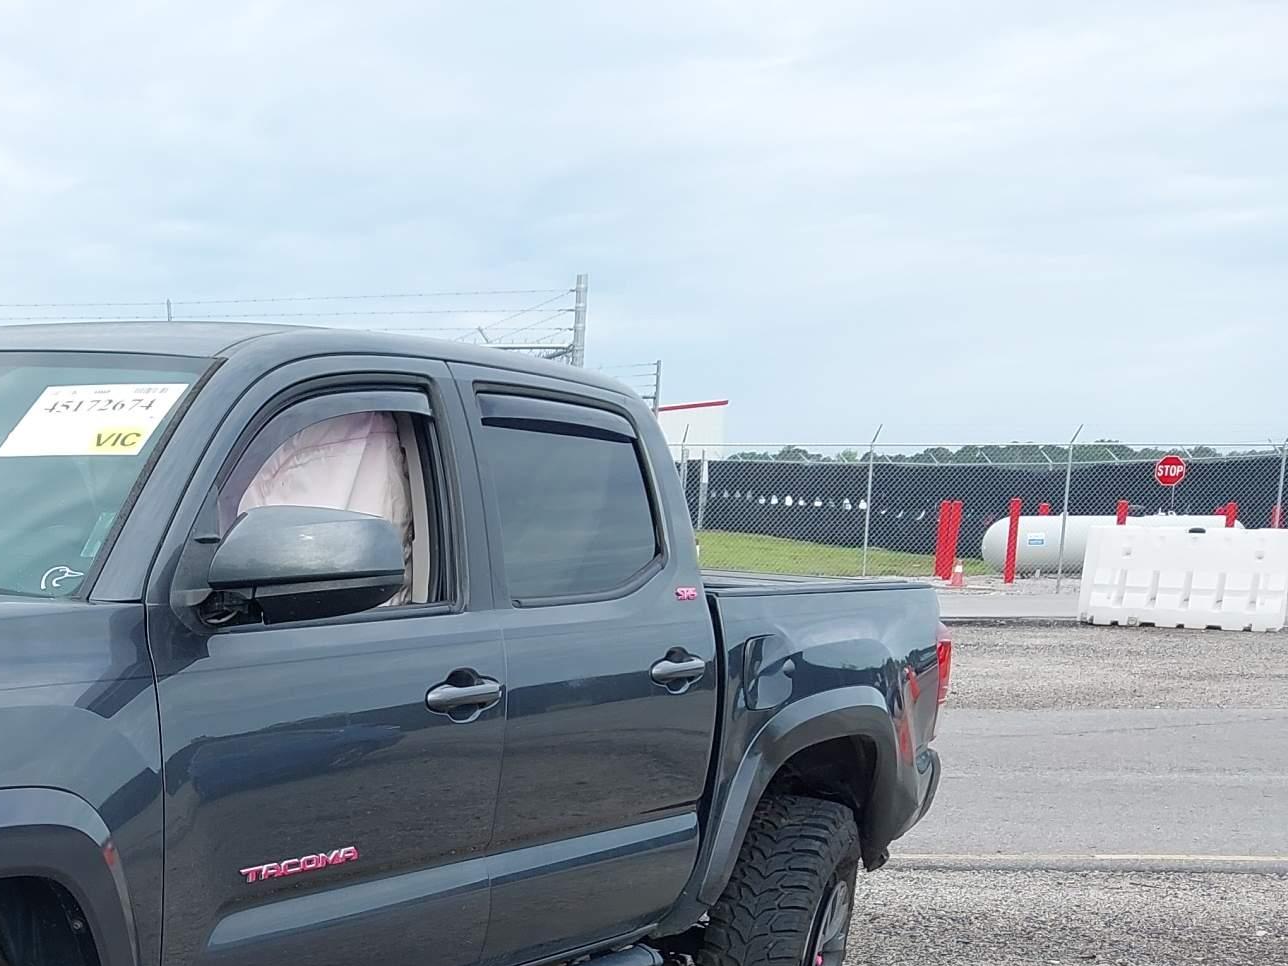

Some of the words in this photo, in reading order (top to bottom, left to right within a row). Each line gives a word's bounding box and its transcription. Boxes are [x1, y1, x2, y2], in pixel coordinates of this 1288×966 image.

[44, 399, 156, 413] 45172674
[95, 432, 141, 447] VIC
[1157, 464, 1184, 477] STOP
[239, 846, 359, 883] TACOMA
